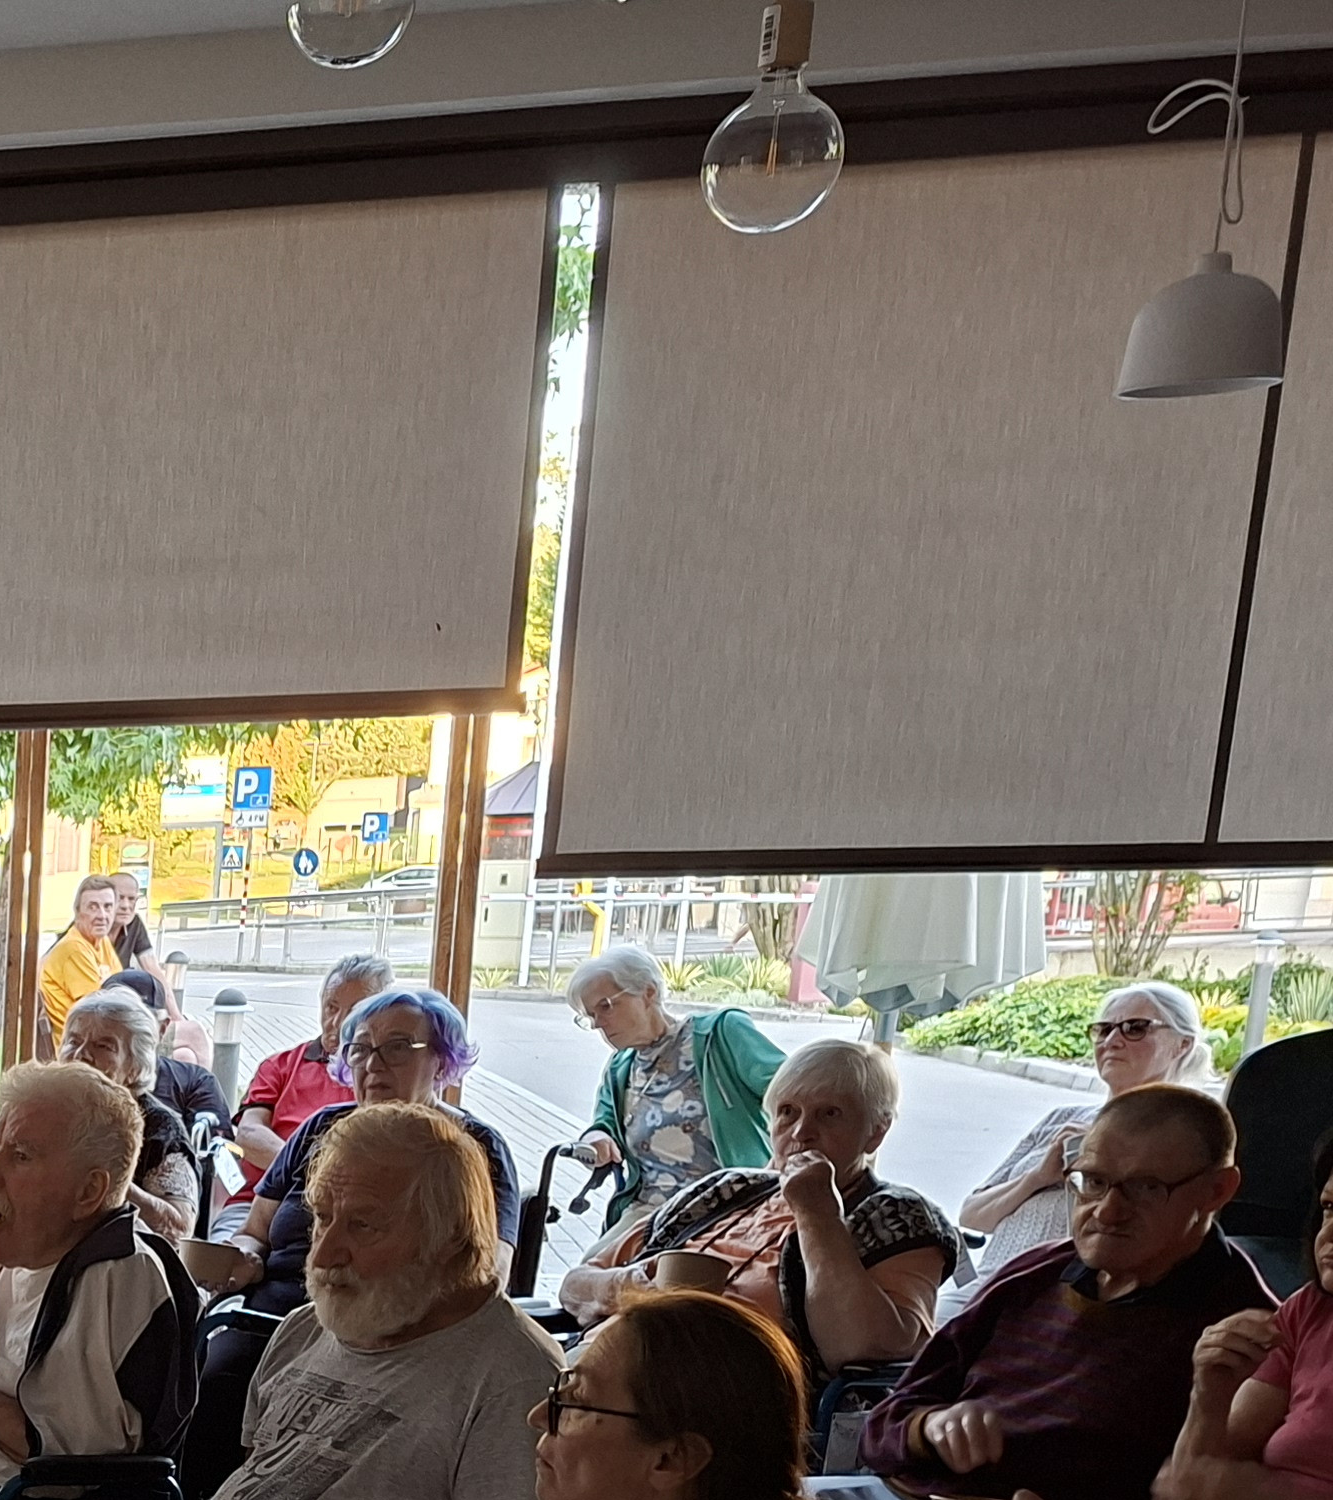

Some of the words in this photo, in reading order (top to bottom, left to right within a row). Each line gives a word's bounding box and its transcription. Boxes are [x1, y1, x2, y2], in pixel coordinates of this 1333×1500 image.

[237, 770, 259, 803] P
[364, 815, 380, 838] P
[274, 1390, 345, 1434] NEW
